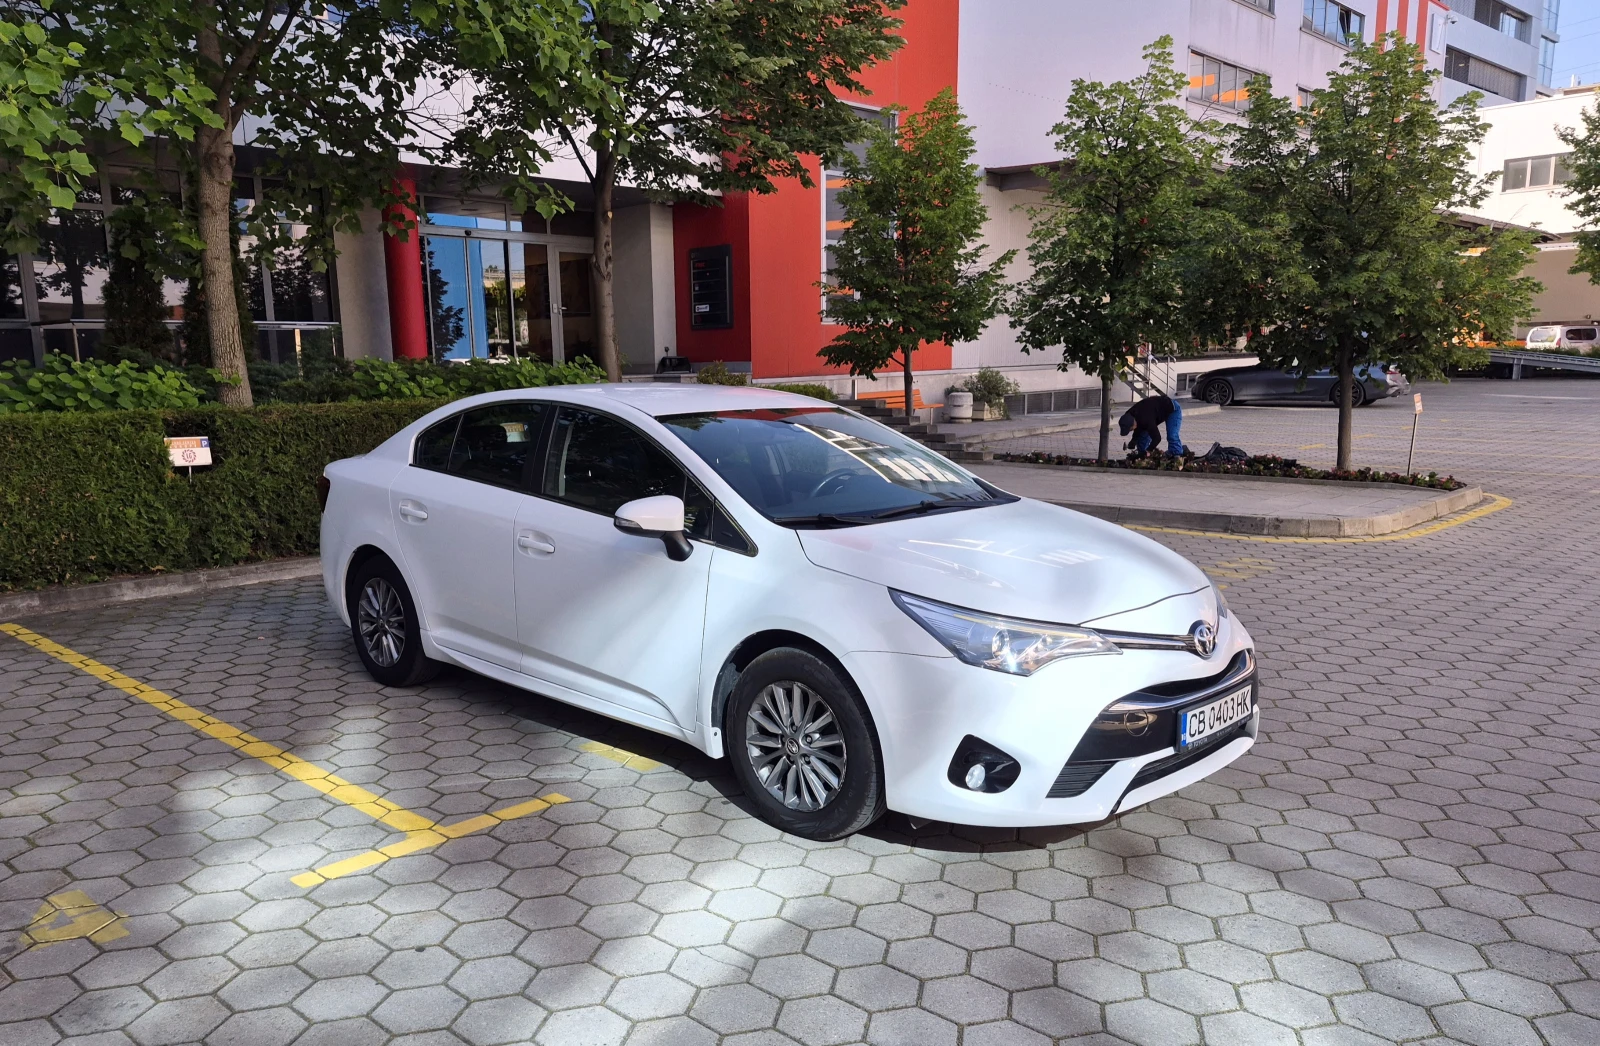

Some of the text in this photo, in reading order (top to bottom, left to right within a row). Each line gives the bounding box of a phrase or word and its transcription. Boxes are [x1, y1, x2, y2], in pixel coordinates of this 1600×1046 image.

[1189, 689, 1249, 737] CB 0403 HK
[1194, 737, 1208, 747] TOYOTA
